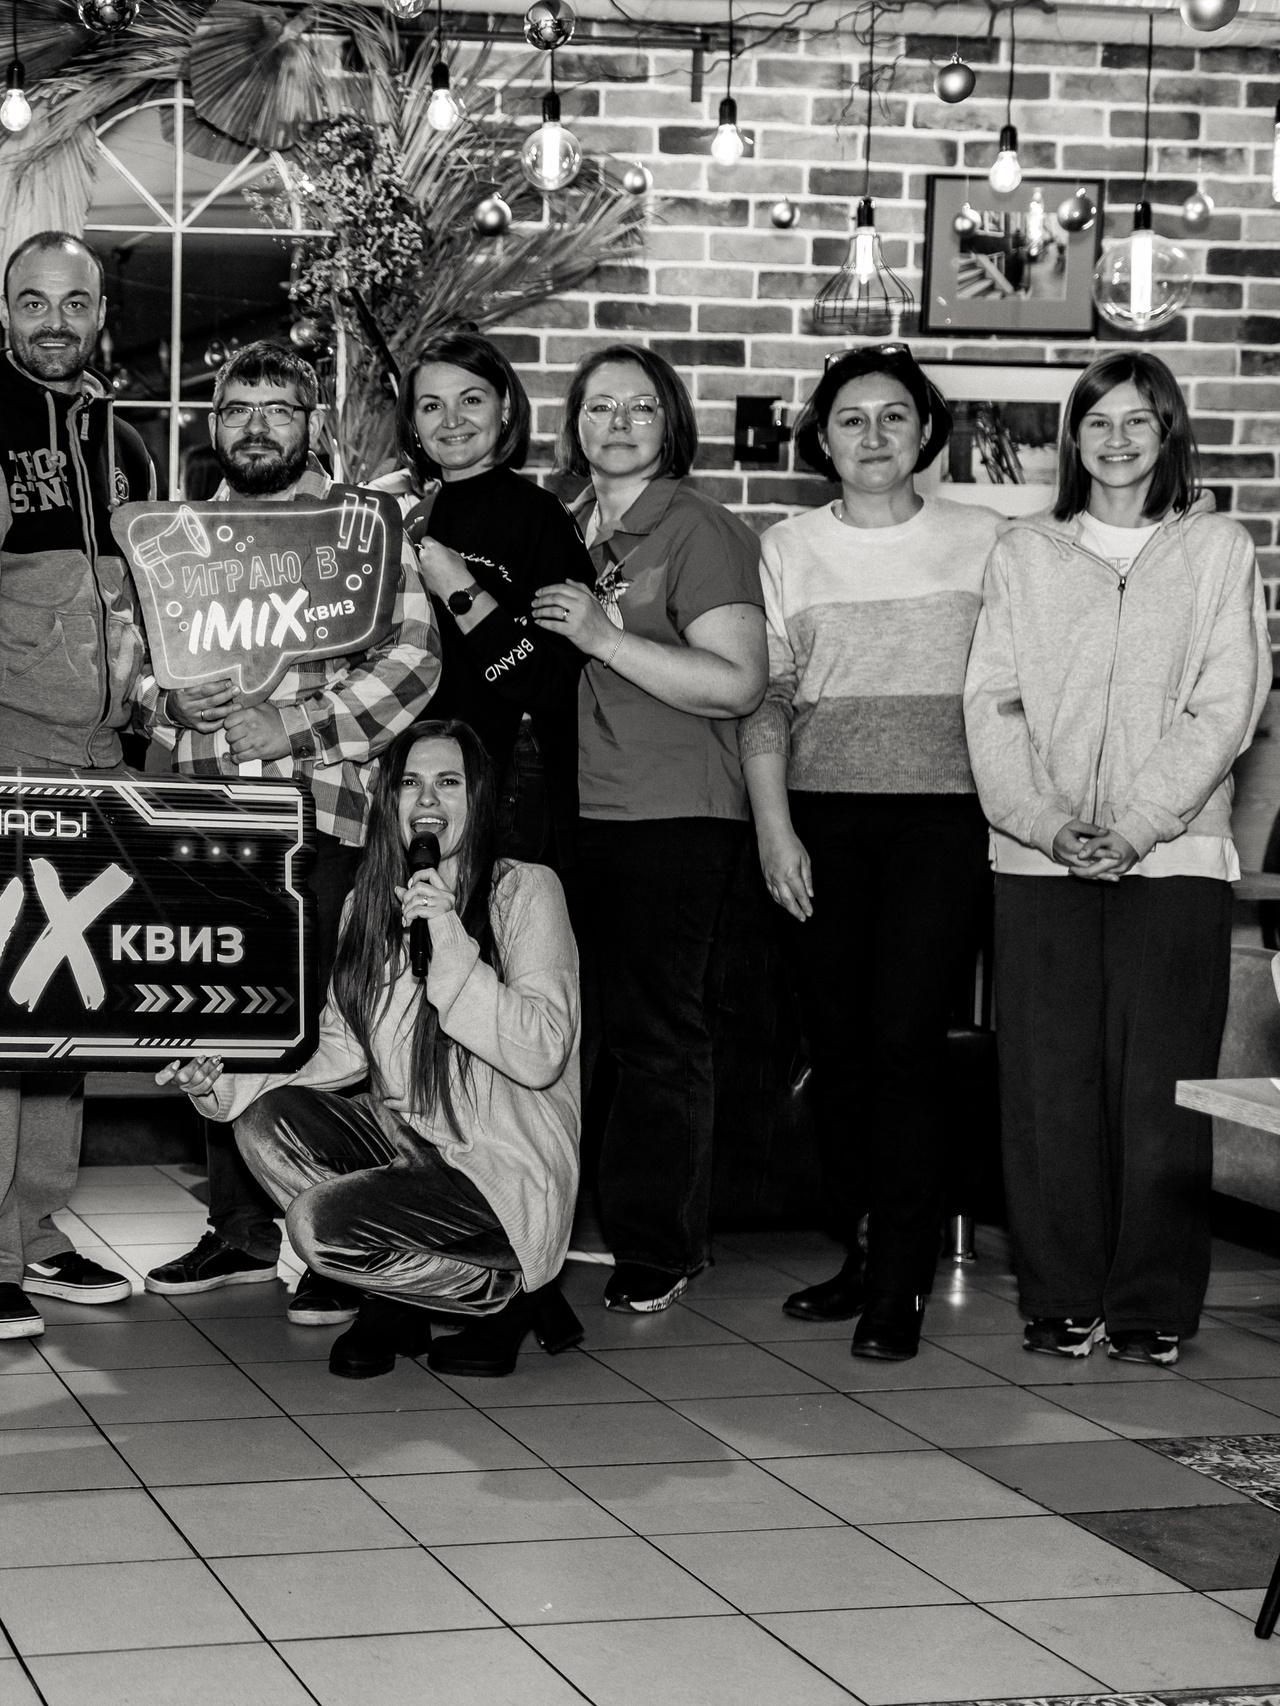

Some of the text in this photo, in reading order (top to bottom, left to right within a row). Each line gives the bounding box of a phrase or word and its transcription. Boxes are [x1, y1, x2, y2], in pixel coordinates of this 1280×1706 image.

[182, 546, 339, 598] ИГРАЮ В
[188, 588, 356, 655] IMIX КВИЗ
[485, 637, 535, 682] BRAND
[111, 923, 246, 964] КВИЗ
